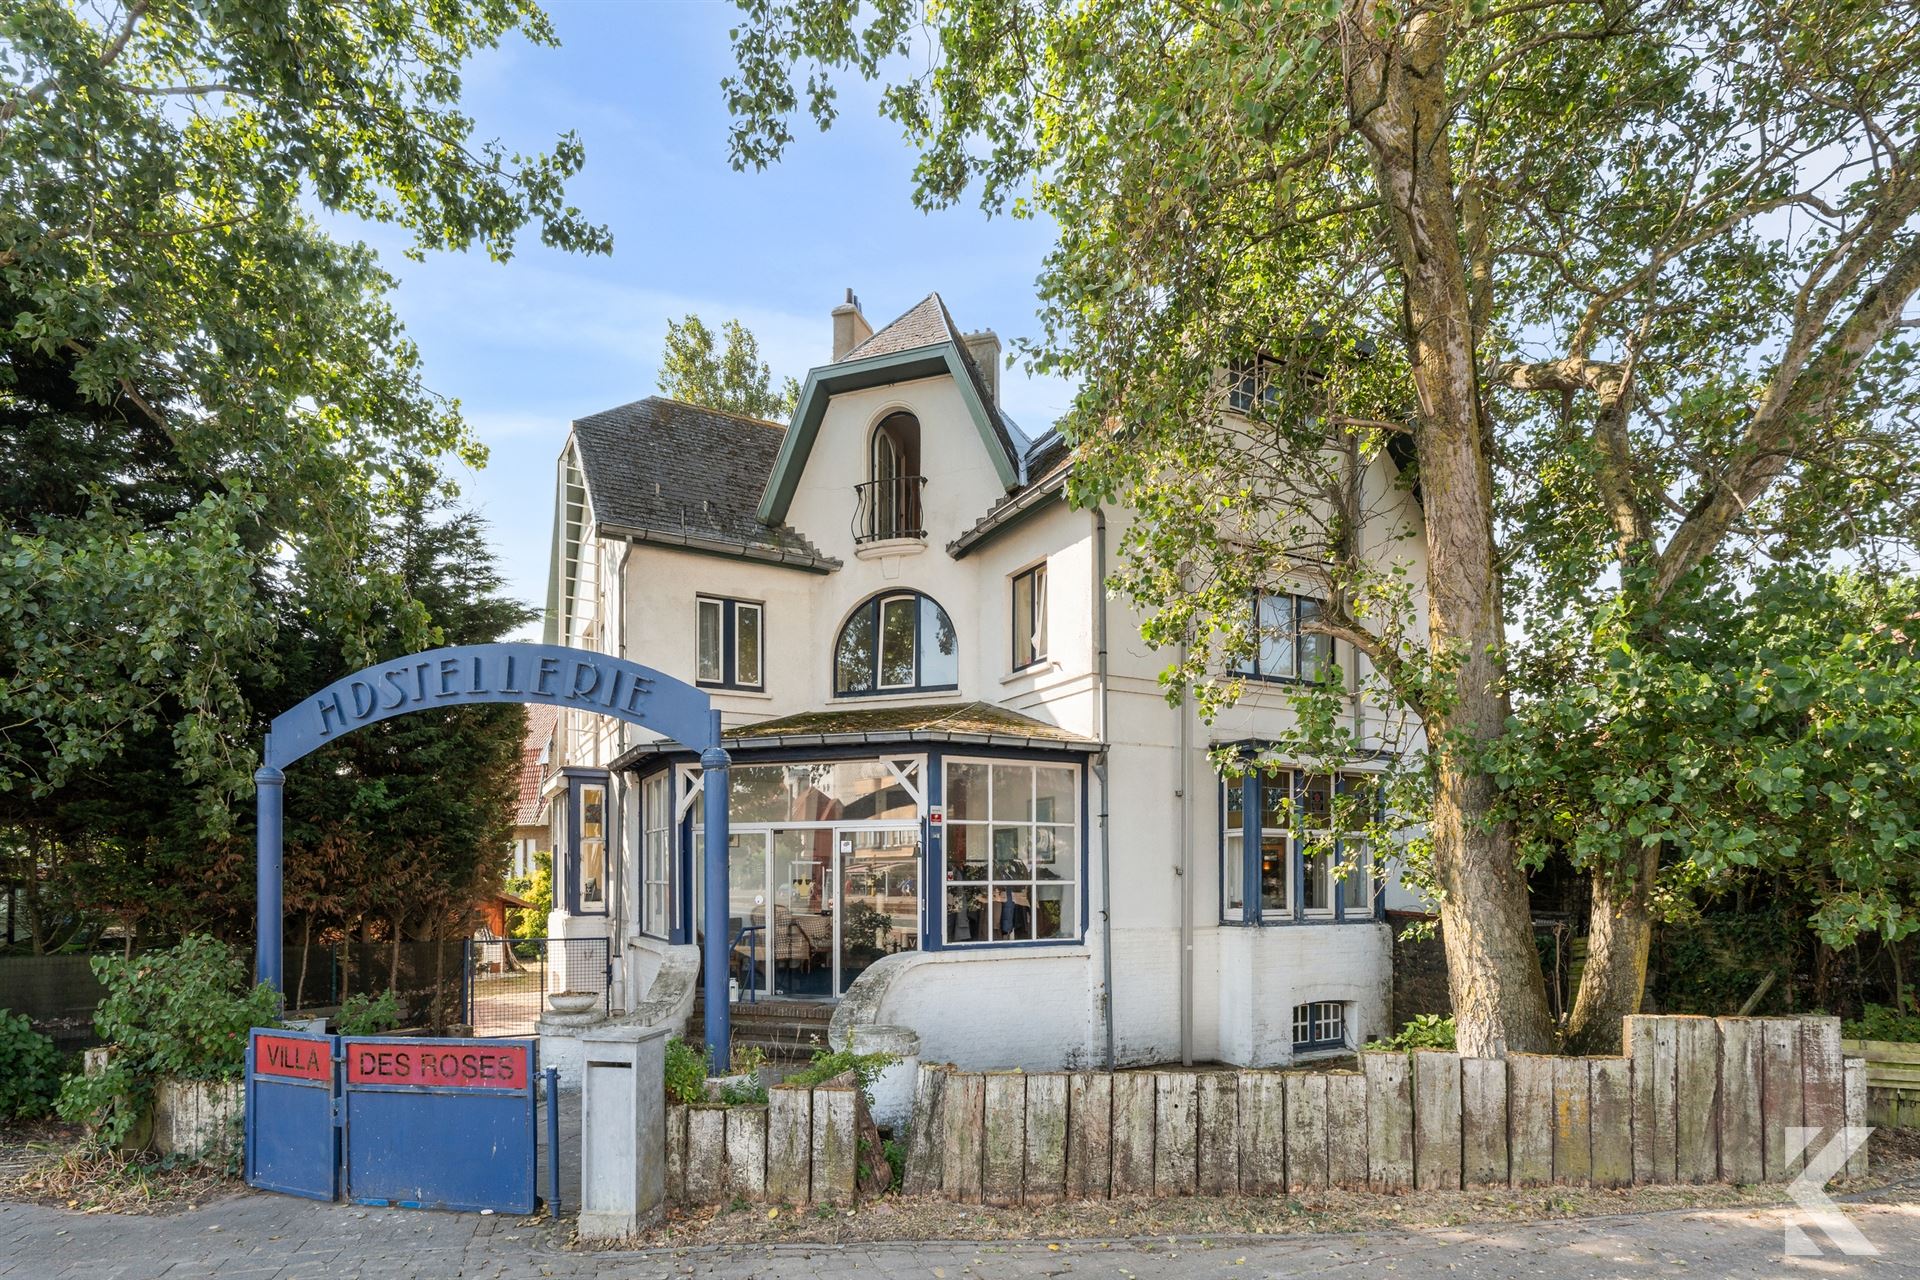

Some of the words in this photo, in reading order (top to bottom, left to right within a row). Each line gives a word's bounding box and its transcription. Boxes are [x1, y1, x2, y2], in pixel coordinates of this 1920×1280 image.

[316, 655, 656, 735] HOSTELLERIE
[267, 1043, 320, 1072] VILLA
[360, 1052, 410, 1077] DES
[420, 1053, 514, 1080] ROSES
